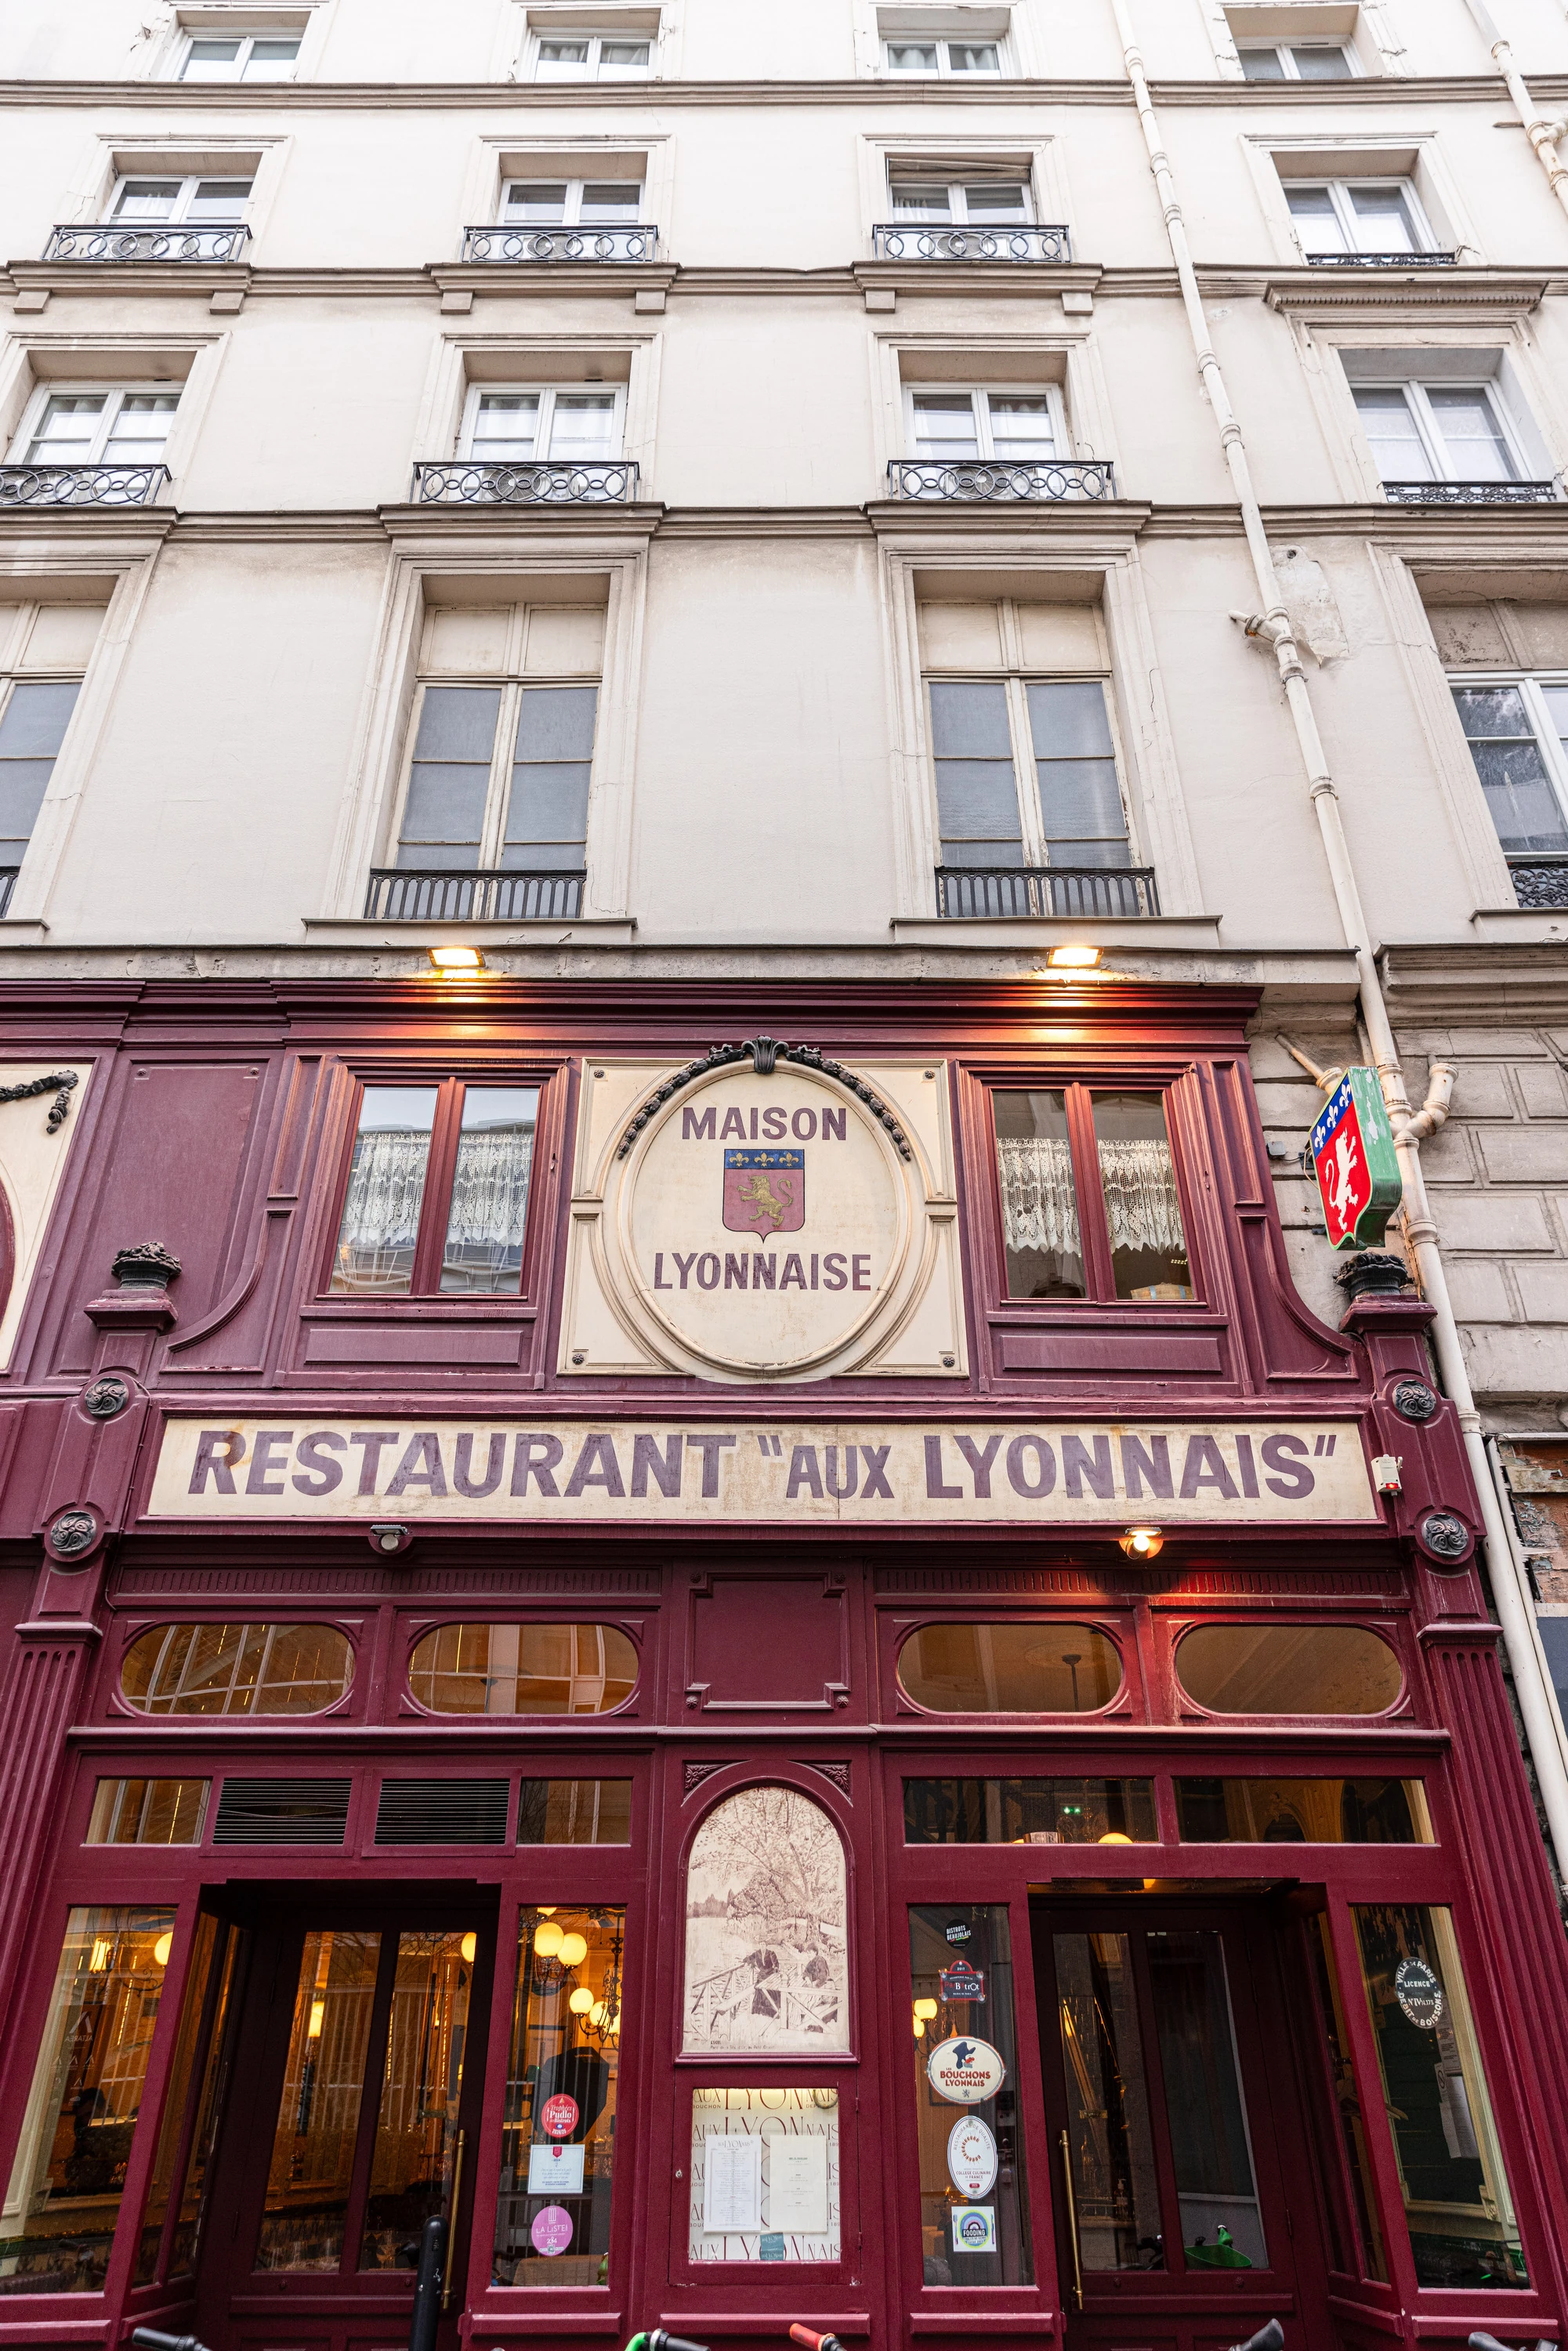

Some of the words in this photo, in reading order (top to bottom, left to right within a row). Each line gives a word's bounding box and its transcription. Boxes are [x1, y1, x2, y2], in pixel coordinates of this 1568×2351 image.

[682, 1107, 846, 1141] MAISON
[654, 1252, 871, 1291] LYONNAISE
[187, 1430, 737, 1499] RESTAURANT
[946, 1925, 966, 1935] BISTROTS
[947, 1929, 972, 1941] BEAUJOLAIS
[1396, 1961, 1410, 1983] VILLE
[1417, 1960, 1436, 1983] PARIS
[1419, 1991, 1442, 2026] BOISSONS
[940, 2070, 991, 2079] BOUCHONS
[549, 2110, 572, 2119] Pudlo
